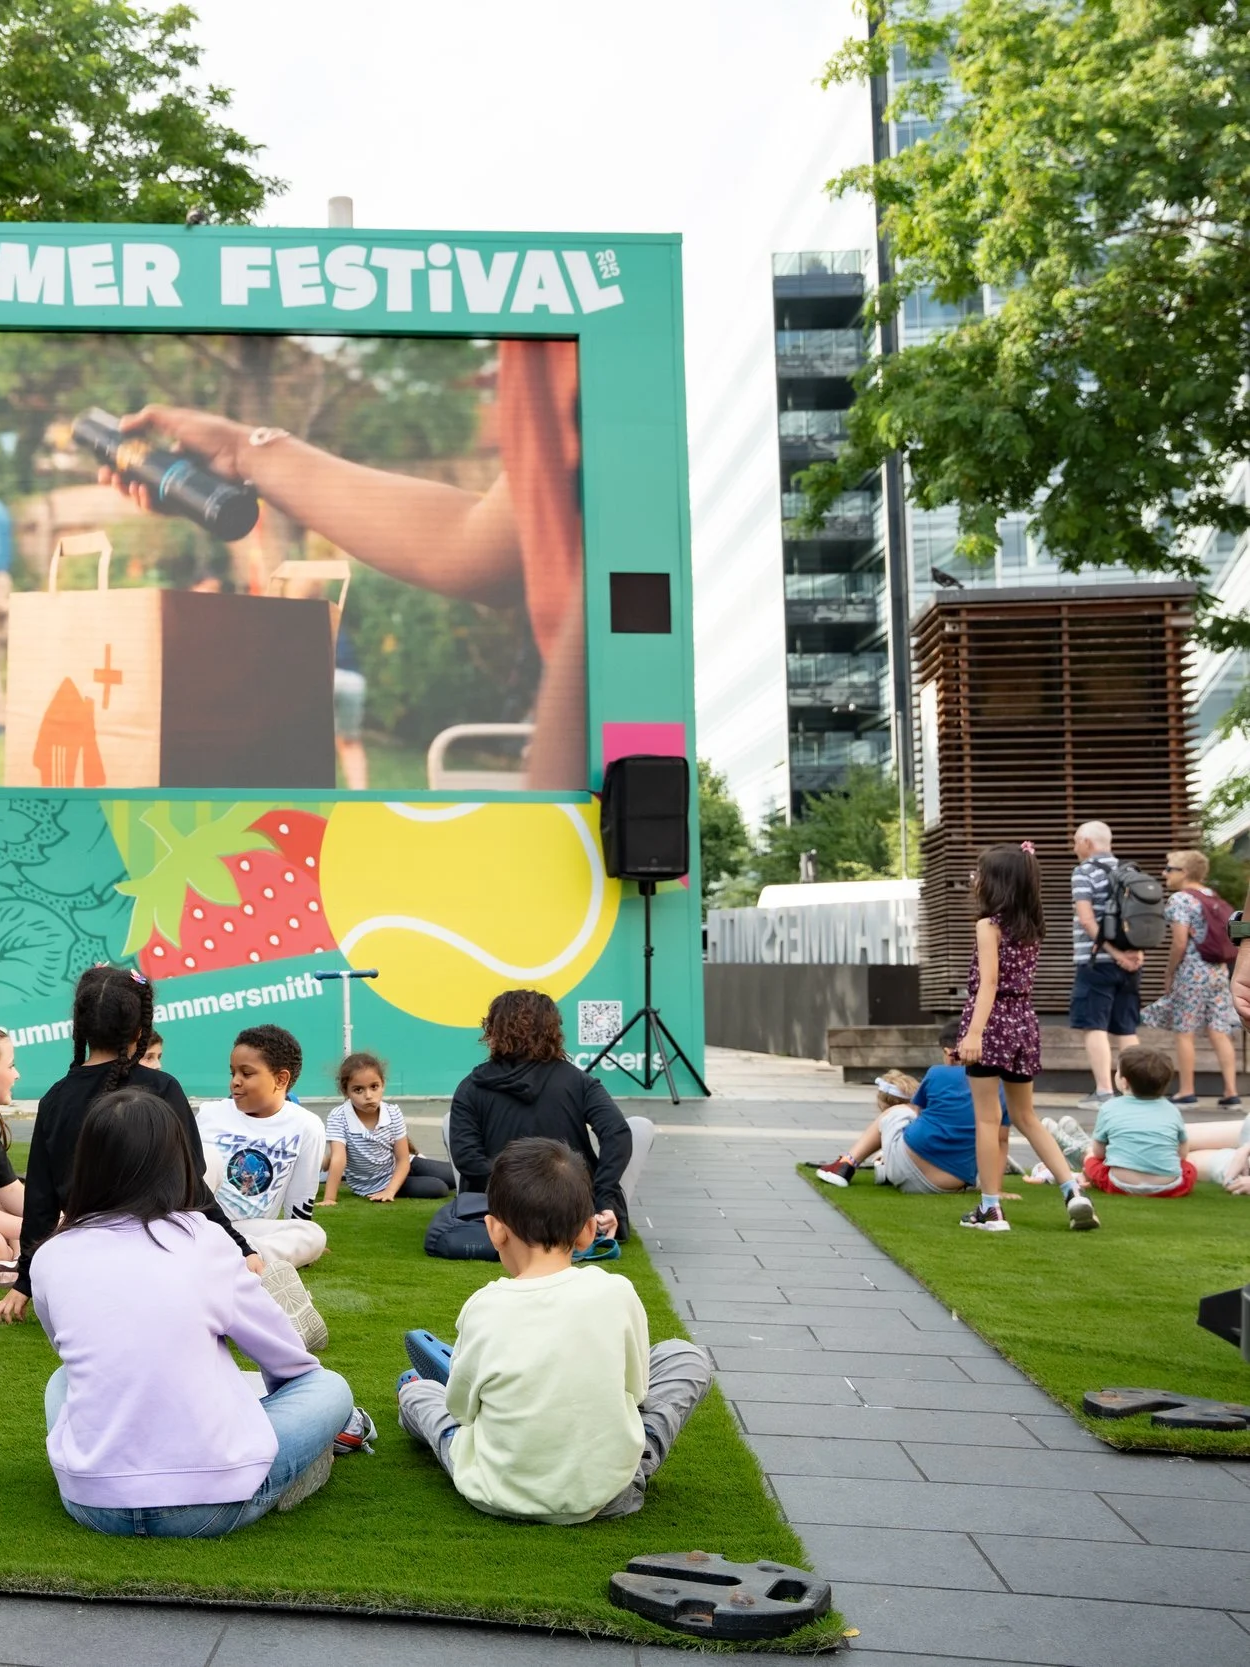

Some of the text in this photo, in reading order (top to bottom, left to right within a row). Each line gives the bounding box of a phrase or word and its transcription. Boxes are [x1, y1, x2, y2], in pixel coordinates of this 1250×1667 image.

[595, 248, 616, 266] 20
[599, 262, 620, 279] 25
[152, 971, 324, 1024] ammersmith
[562, 1051, 665, 1072] creens
